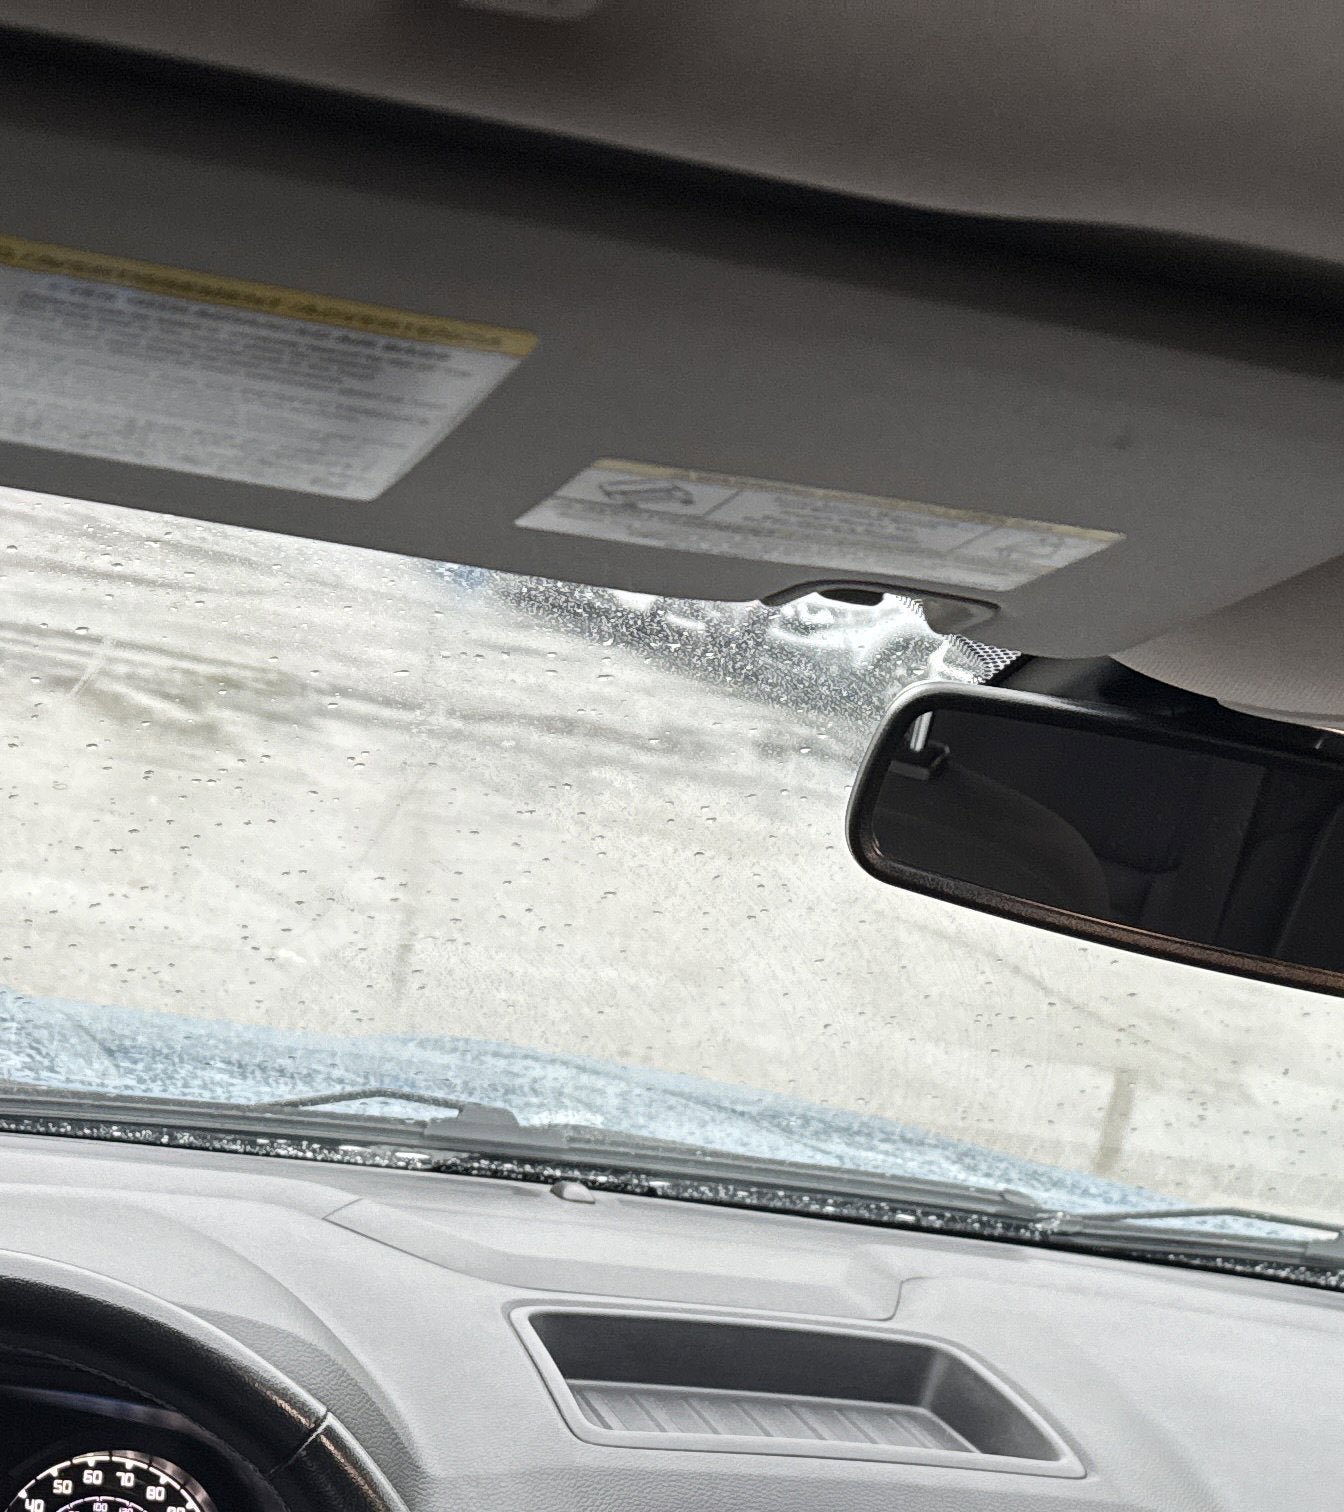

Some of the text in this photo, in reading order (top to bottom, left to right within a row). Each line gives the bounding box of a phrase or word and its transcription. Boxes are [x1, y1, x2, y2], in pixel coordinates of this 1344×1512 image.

[82, 1470, 103, 1485] 60
[116, 1471, 135, 1487] 70
[52, 1479, 73, 1495] 50
[146, 1486, 166, 1502] 80
[93, 1502, 108, 1512] 100
